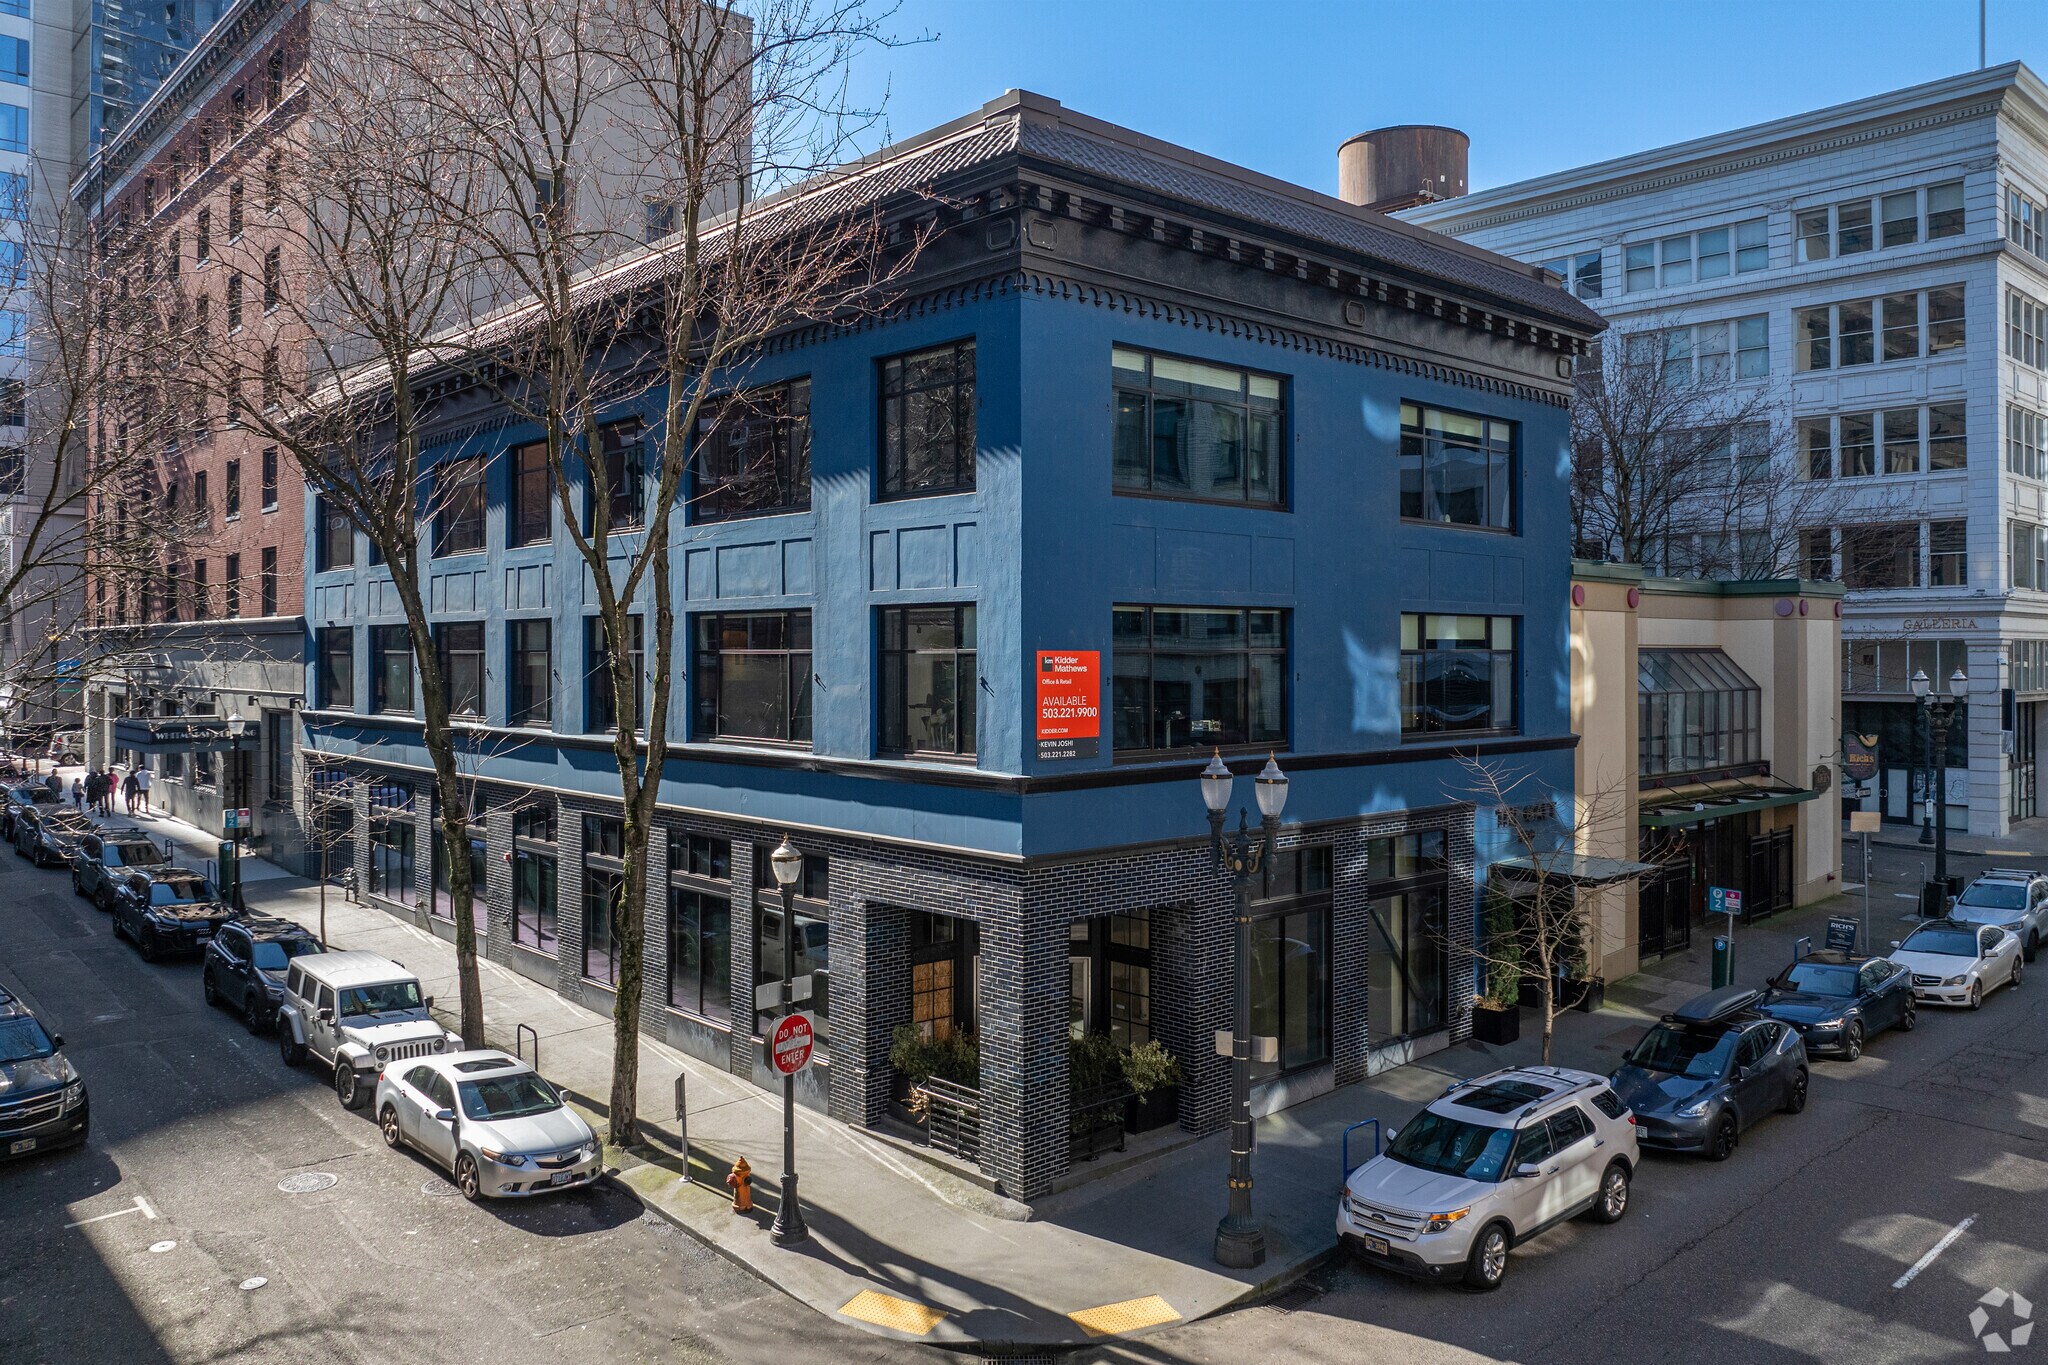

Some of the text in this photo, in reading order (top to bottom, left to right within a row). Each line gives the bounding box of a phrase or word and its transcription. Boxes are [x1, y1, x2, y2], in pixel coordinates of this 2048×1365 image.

[1903, 618, 1978, 629] GALLERIA
[1054, 656, 1078, 664] Kidder
[1042, 696, 1087, 706] AVAILABLE
[1042, 707, 1097, 718] 503.221.9900
[1040, 750, 1076, 759] 503.221.2282
[228, 818, 235, 826] 2
[1714, 899, 1722, 909] 2
[779, 1023, 807, 1039] DO NOT
[782, 1050, 804, 1064] ENTER
